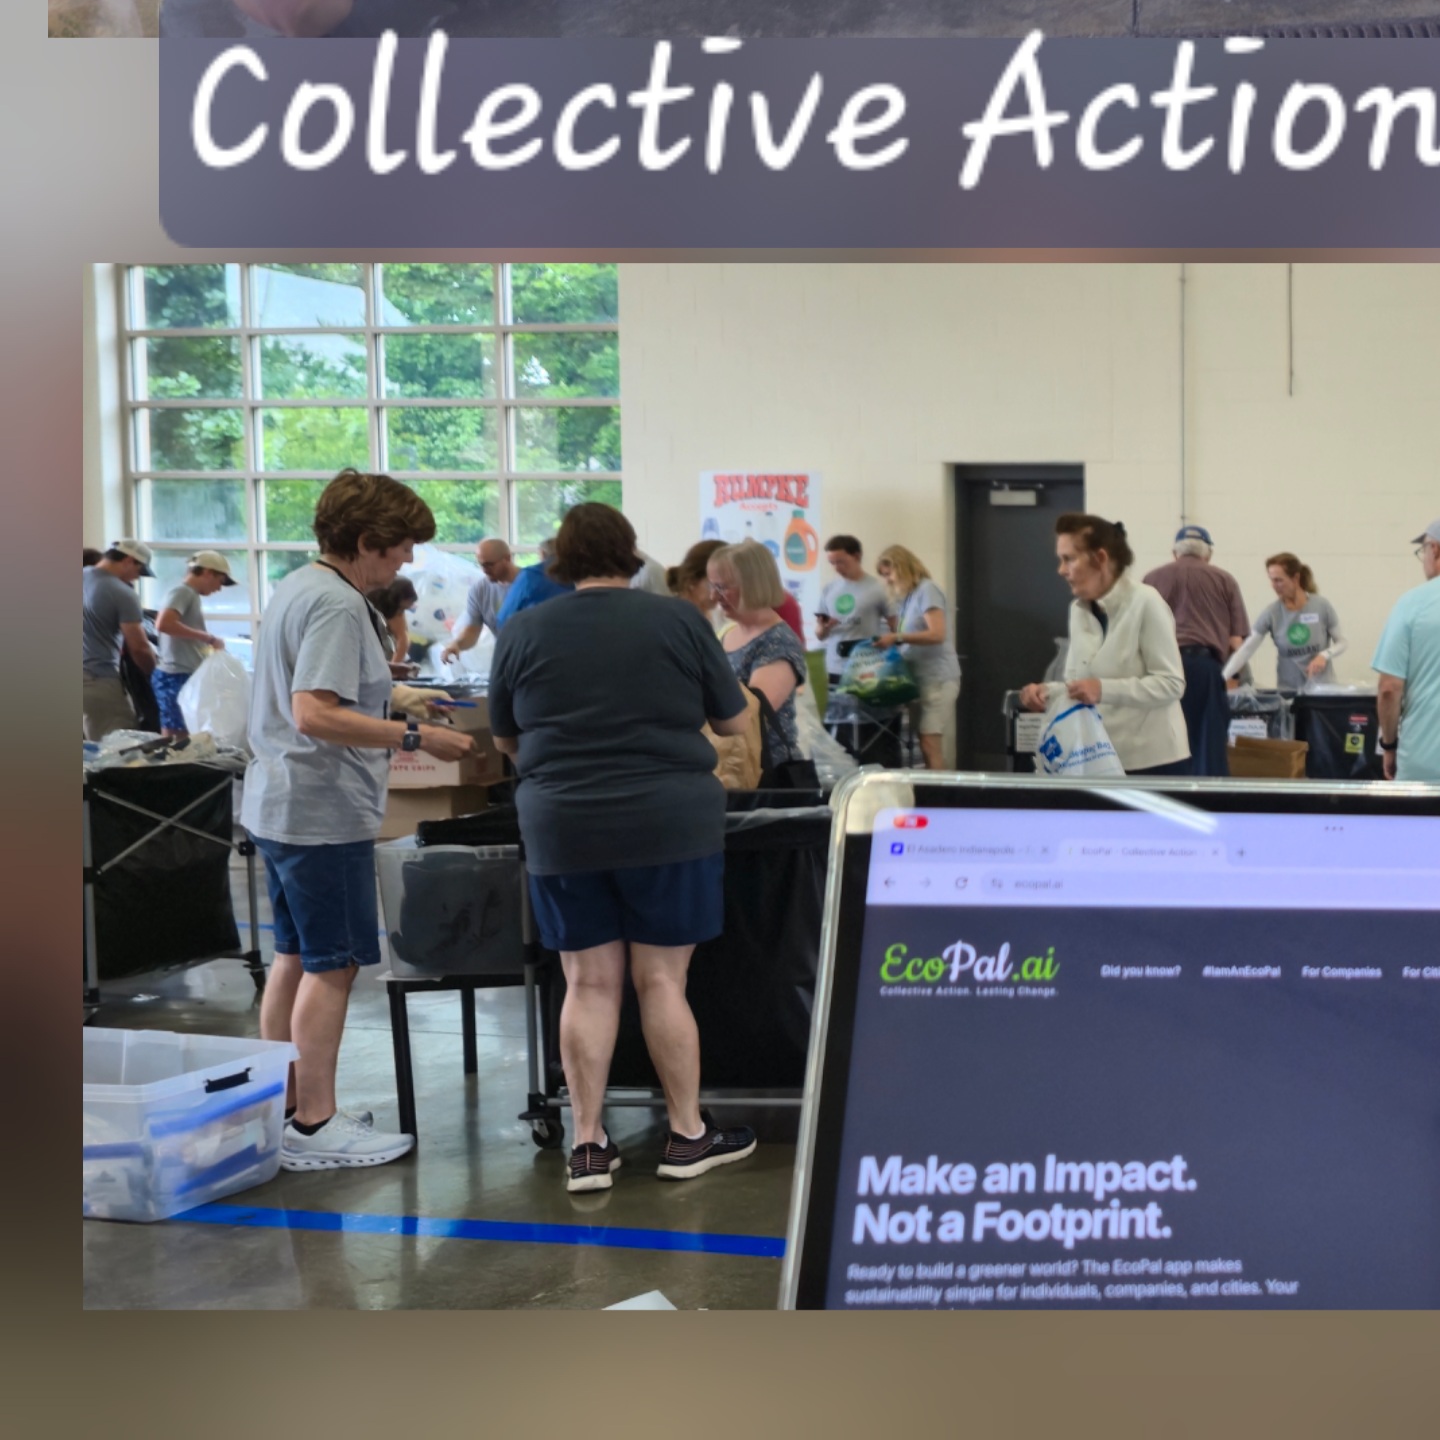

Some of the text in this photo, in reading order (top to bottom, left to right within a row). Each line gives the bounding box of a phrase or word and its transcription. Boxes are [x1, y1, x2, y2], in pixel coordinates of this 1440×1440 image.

[713, 474, 809, 509] RUMPKE
[880, 939, 1060, 984] EcoPal.ai
[1100, 963, 1182, 980] Did you know?
[1302, 965, 1383, 981] For Companies
[1402, 965, 1421, 978] For
[879, 985, 1059, 999] Collective Action. Lasting Change.
[857, 1154, 1197, 1201] Make an Impact.
[852, 1198, 1172, 1249] Not a Footprint.
[847, 1257, 1243, 1284] Ready to build a greener world? The EcoPal app makes
[844, 1278, 1299, 1306] sustainability simple for individuals, companies, and cities. Your
